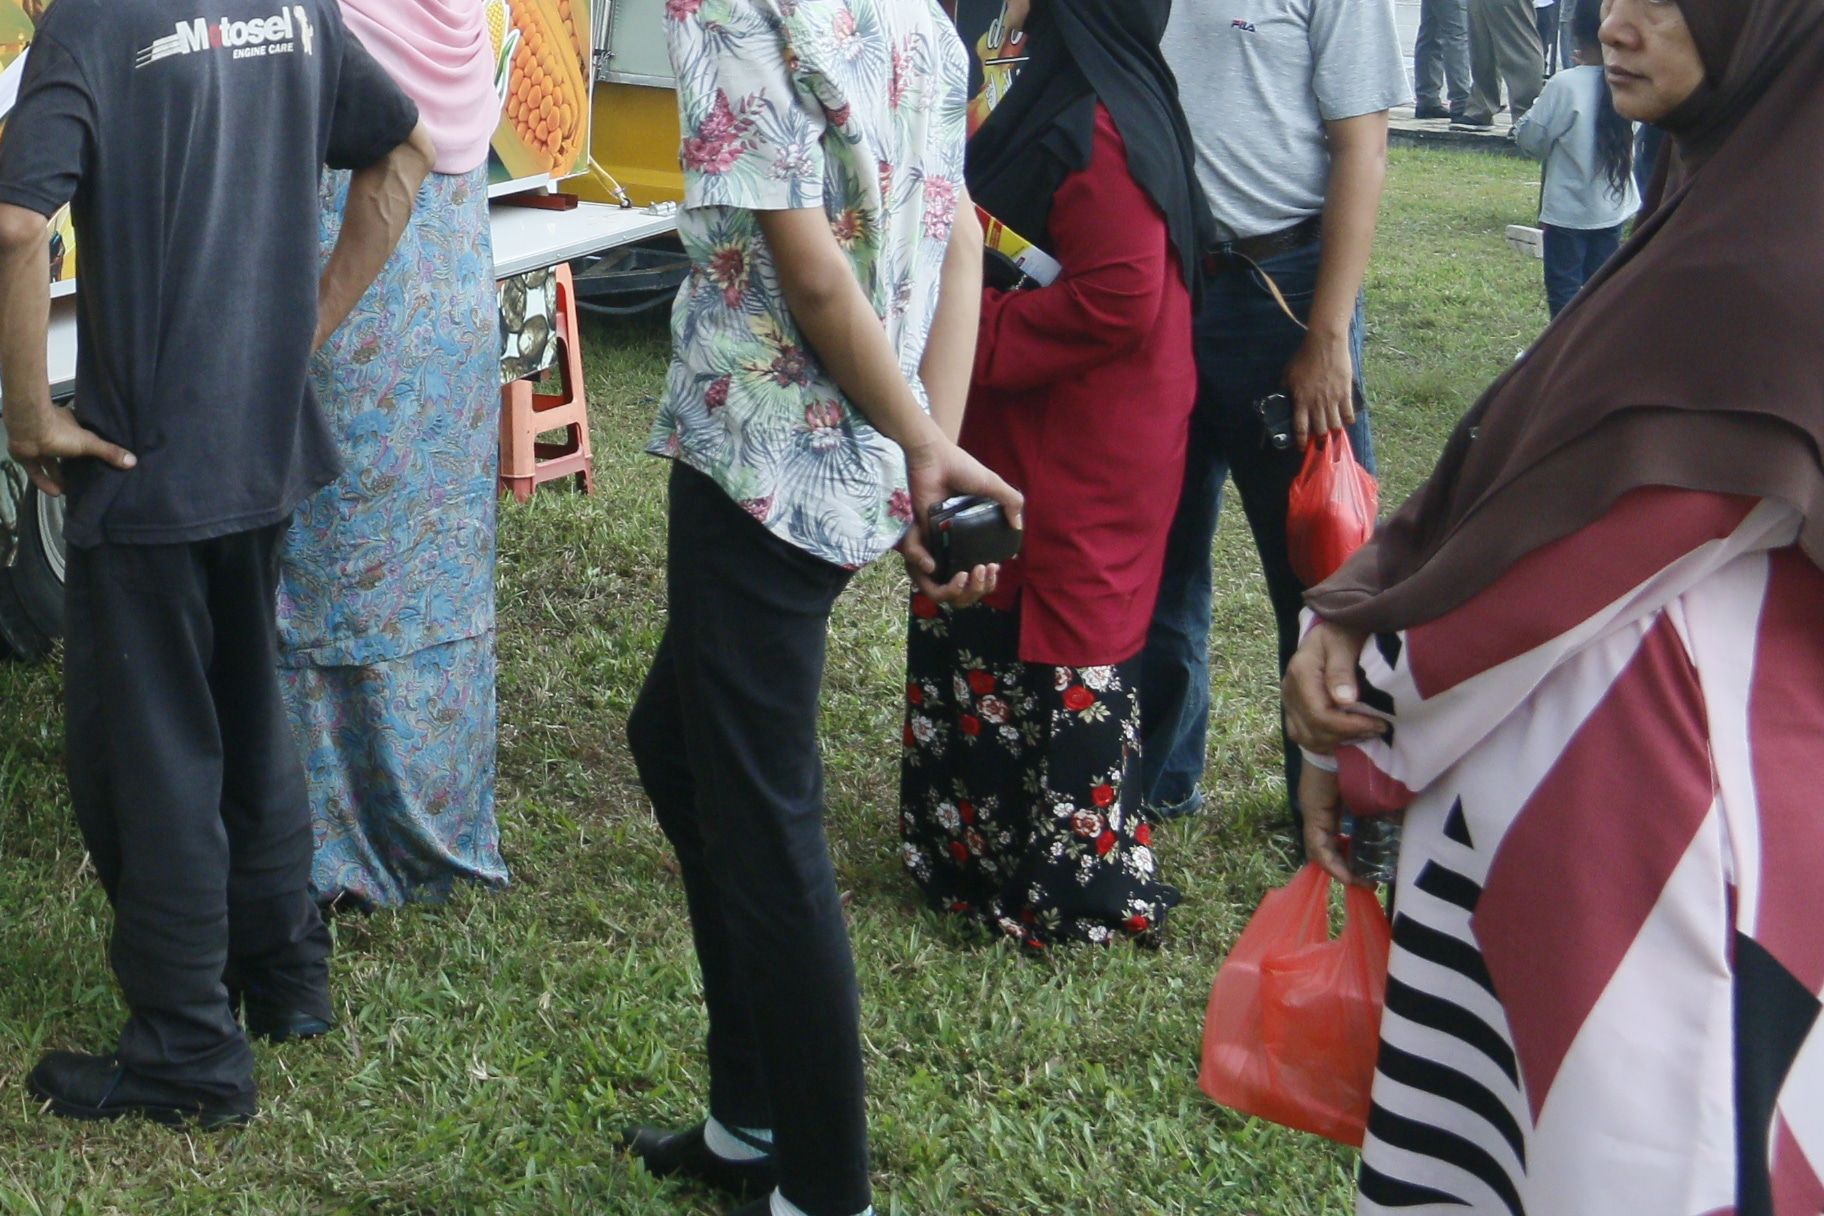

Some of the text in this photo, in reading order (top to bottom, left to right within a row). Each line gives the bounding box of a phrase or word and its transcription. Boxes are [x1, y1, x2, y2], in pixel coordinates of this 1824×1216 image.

[173, 6, 294, 55] Motosel
[233, 42, 294, 59] ENGINE CARE
